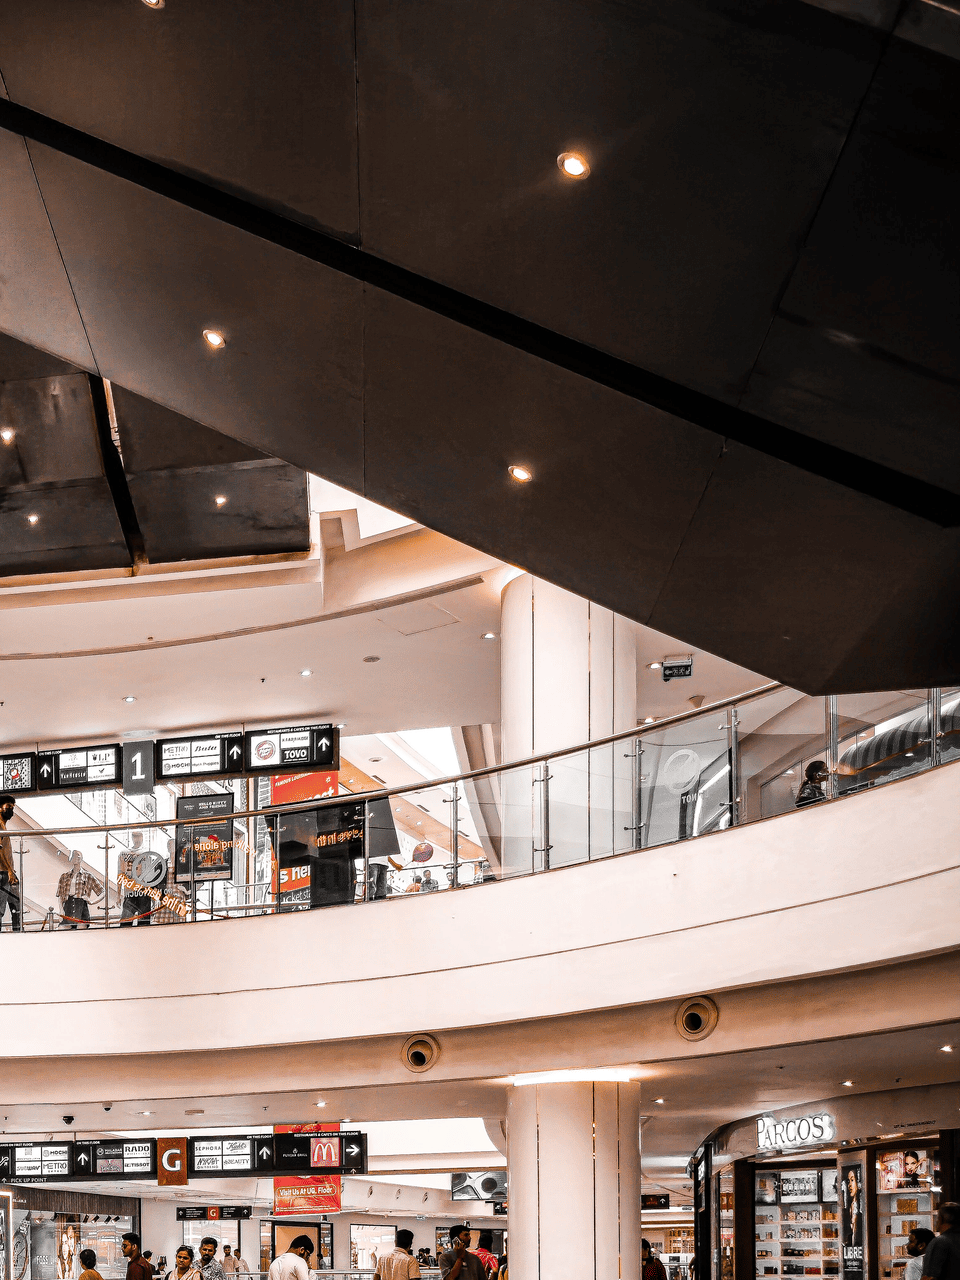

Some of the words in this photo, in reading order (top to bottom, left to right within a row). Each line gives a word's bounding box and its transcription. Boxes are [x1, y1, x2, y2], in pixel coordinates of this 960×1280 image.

[284, 749, 307, 759] TOVO
[131, 752, 146, 780] 1
[756, 1116, 824, 1147] PARCOS
[125, 1145, 150, 1153] RADO
[162, 1148, 182, 1172] G
[43, 1162, 67, 1170] METRO
[279, 1188, 292, 1196] Visit
[318, 1186, 333, 1194] Floor
[209, 1209, 217, 1217] G
[843, 1246, 863, 1259] LIBRE
